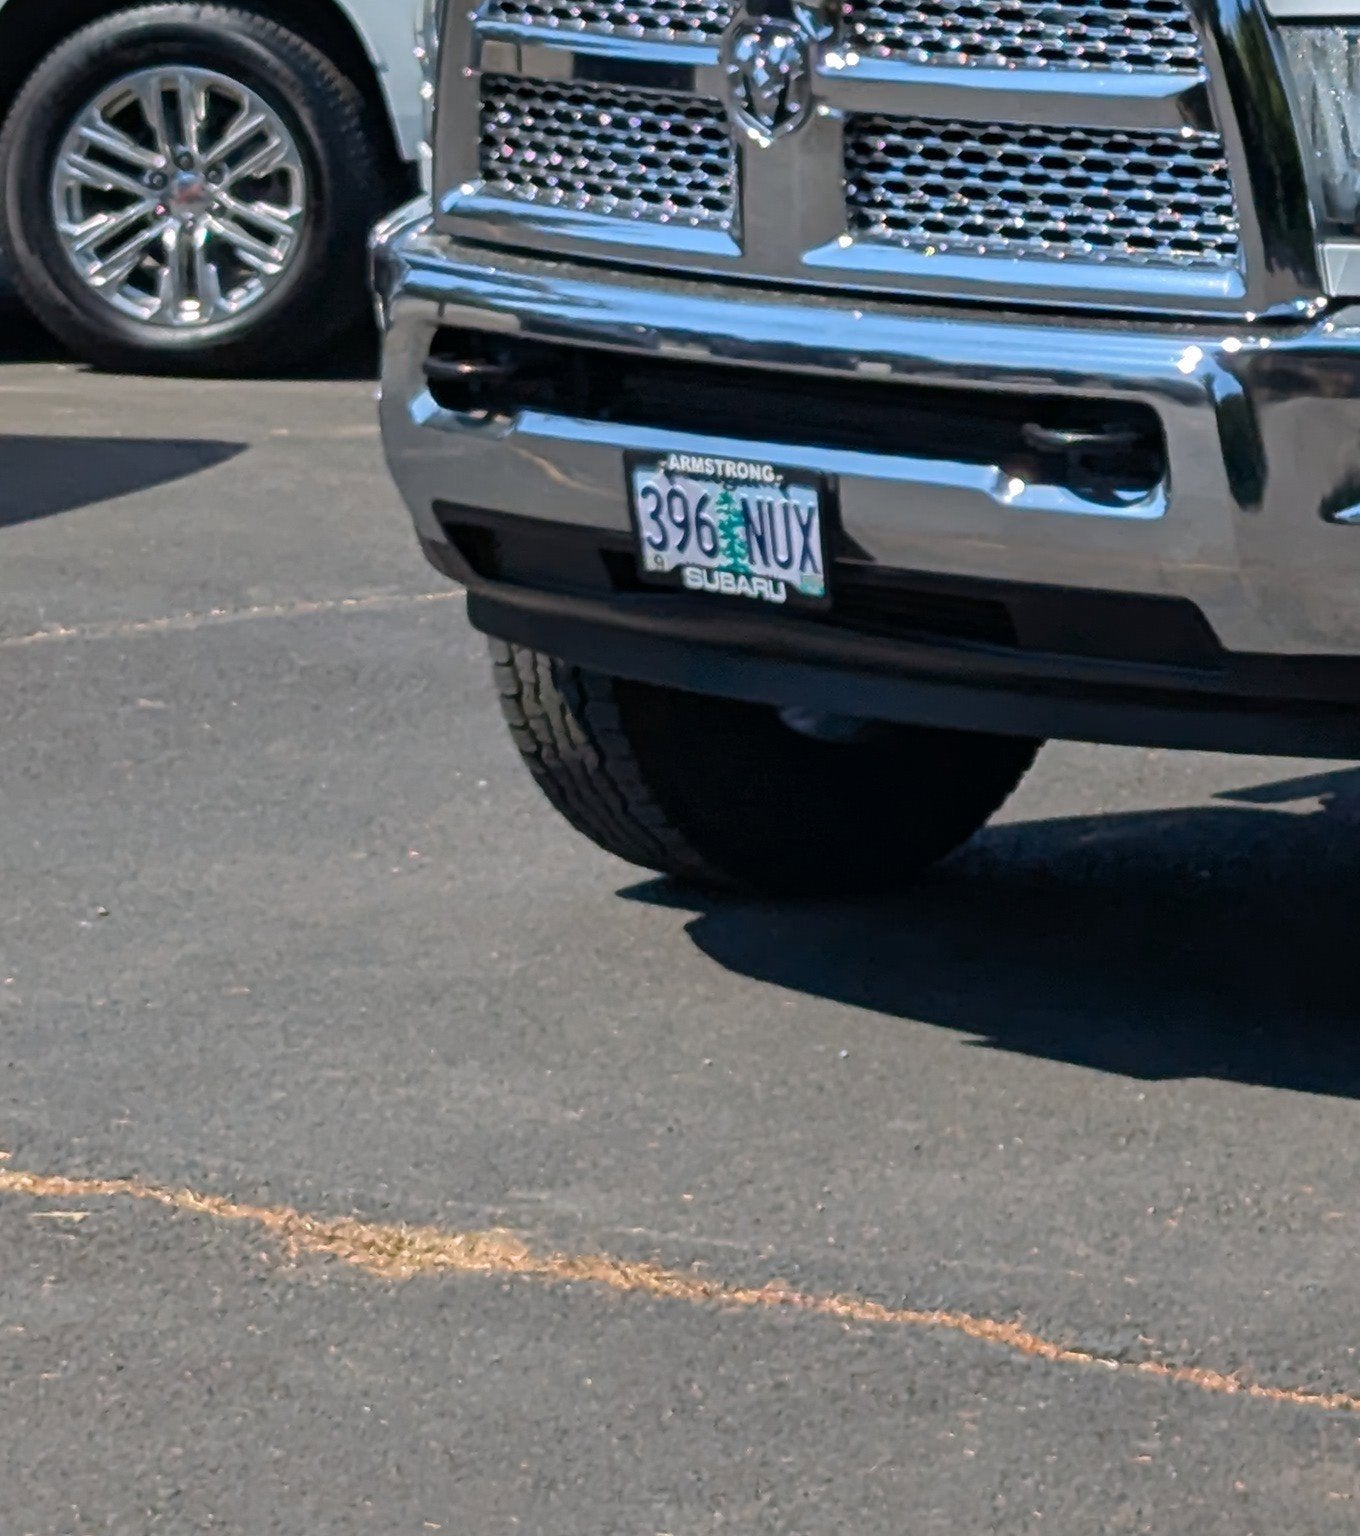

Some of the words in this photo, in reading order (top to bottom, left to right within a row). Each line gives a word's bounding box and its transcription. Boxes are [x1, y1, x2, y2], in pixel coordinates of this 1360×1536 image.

[668, 453, 776, 482] ARMSTRONG
[641, 485, 720, 559] 396
[740, 496, 819, 575] NUX
[683, 567, 787, 604] SUBARU
